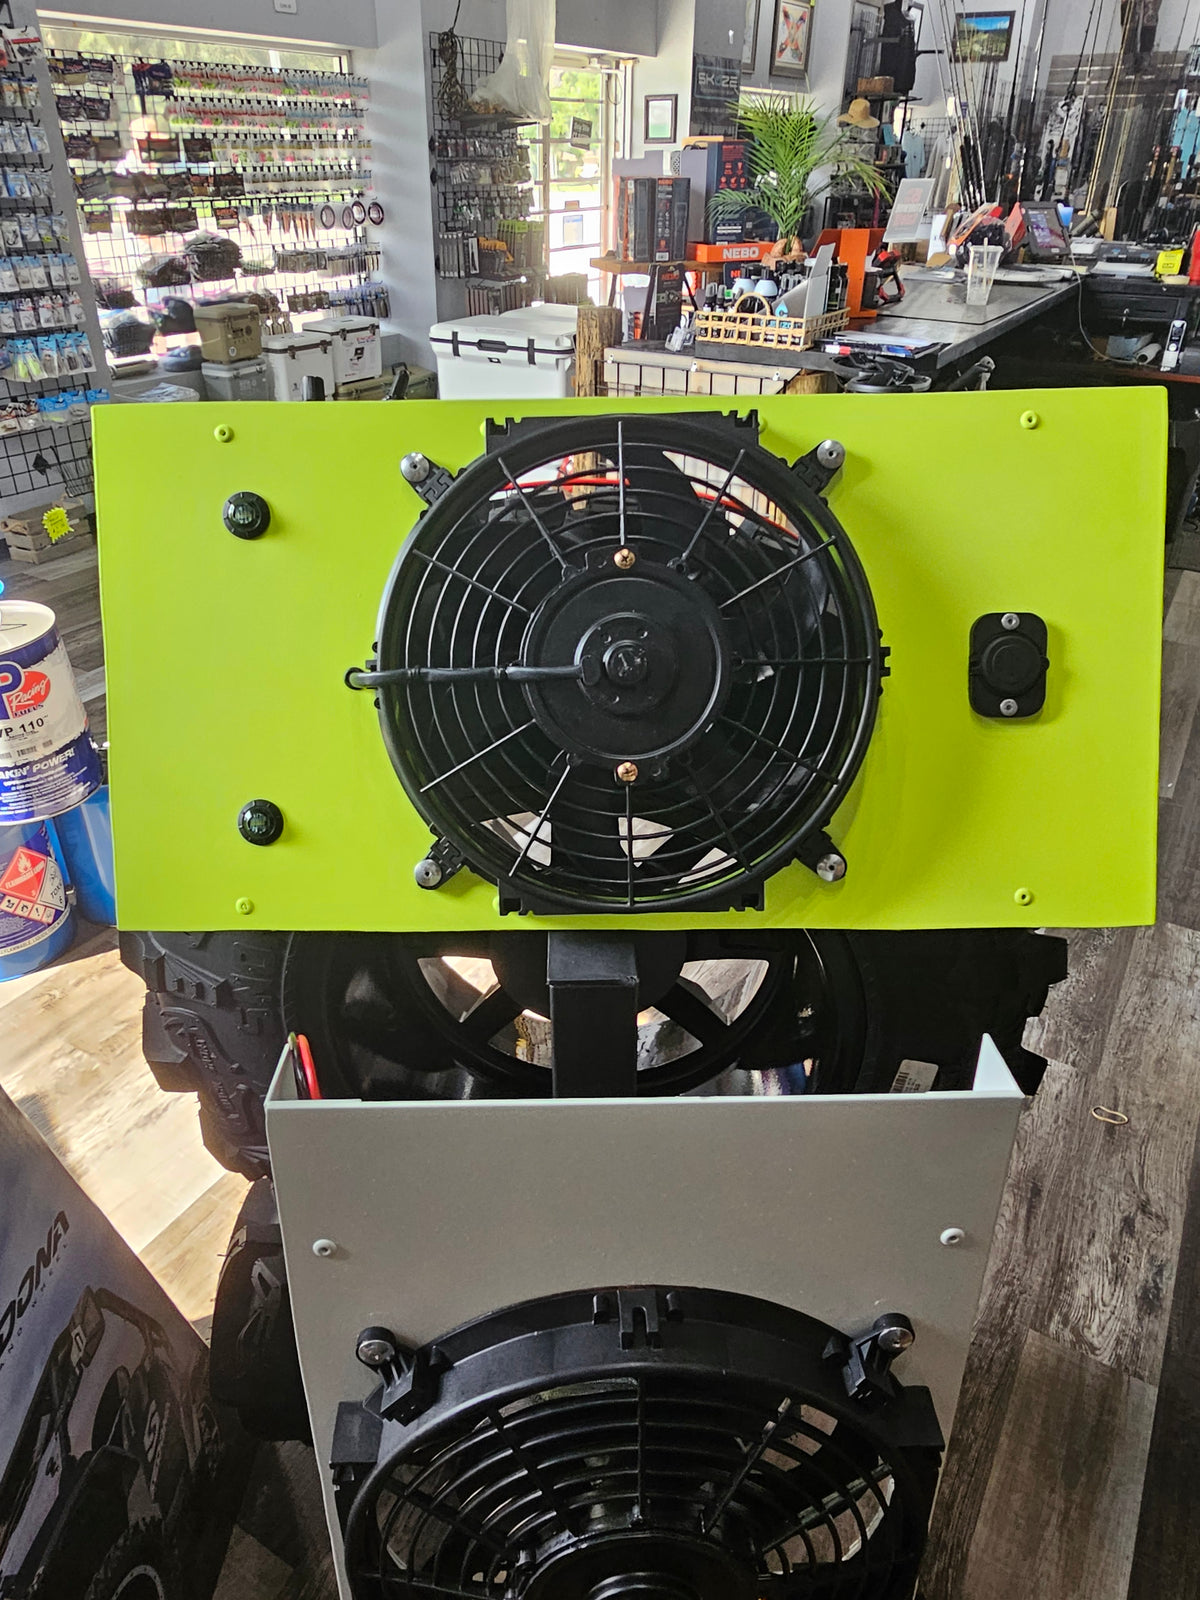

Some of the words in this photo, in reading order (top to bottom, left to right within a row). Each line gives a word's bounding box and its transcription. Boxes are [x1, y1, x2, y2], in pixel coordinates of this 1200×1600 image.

[723, 247, 759, 259] NEBO
[0, 663, 22, 720] P
[9, 677, 49, 712] Racing
[19, 717, 44, 732] 110
[0, 765, 30, 779] AKIN'
[32, 747, 76, 773] POWER!
[0, 1210, 70, 1358] DONA
